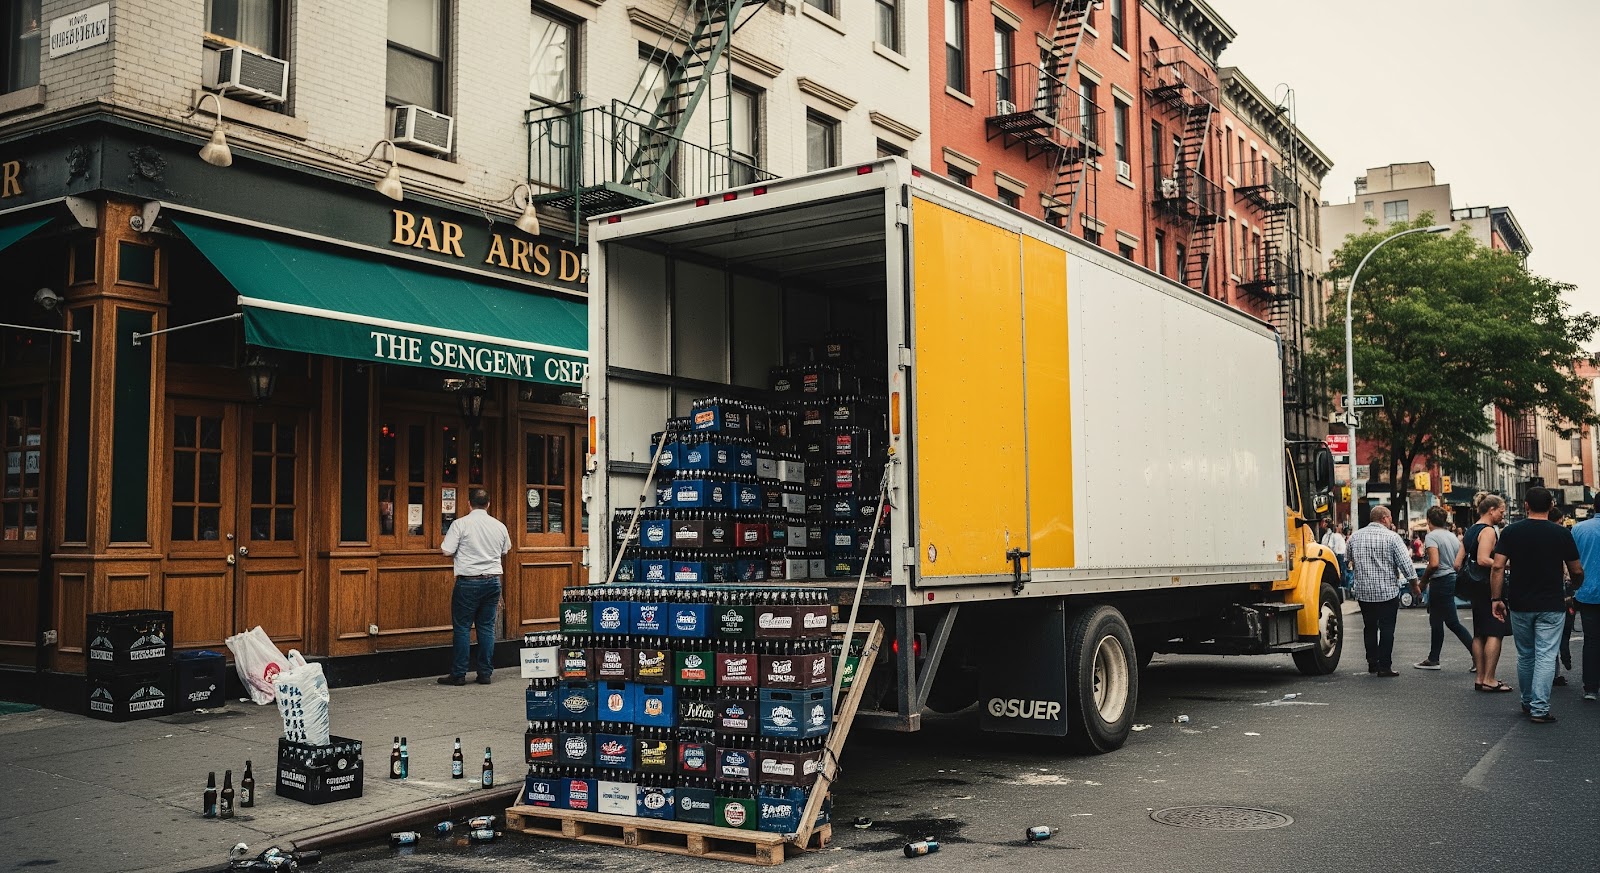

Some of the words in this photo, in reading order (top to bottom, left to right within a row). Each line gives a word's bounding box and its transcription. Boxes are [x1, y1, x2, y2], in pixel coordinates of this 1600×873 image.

[392, 209, 466, 258] BAR
[370, 331, 422, 363] THE
[430, 341, 535, 378] SENGENT
